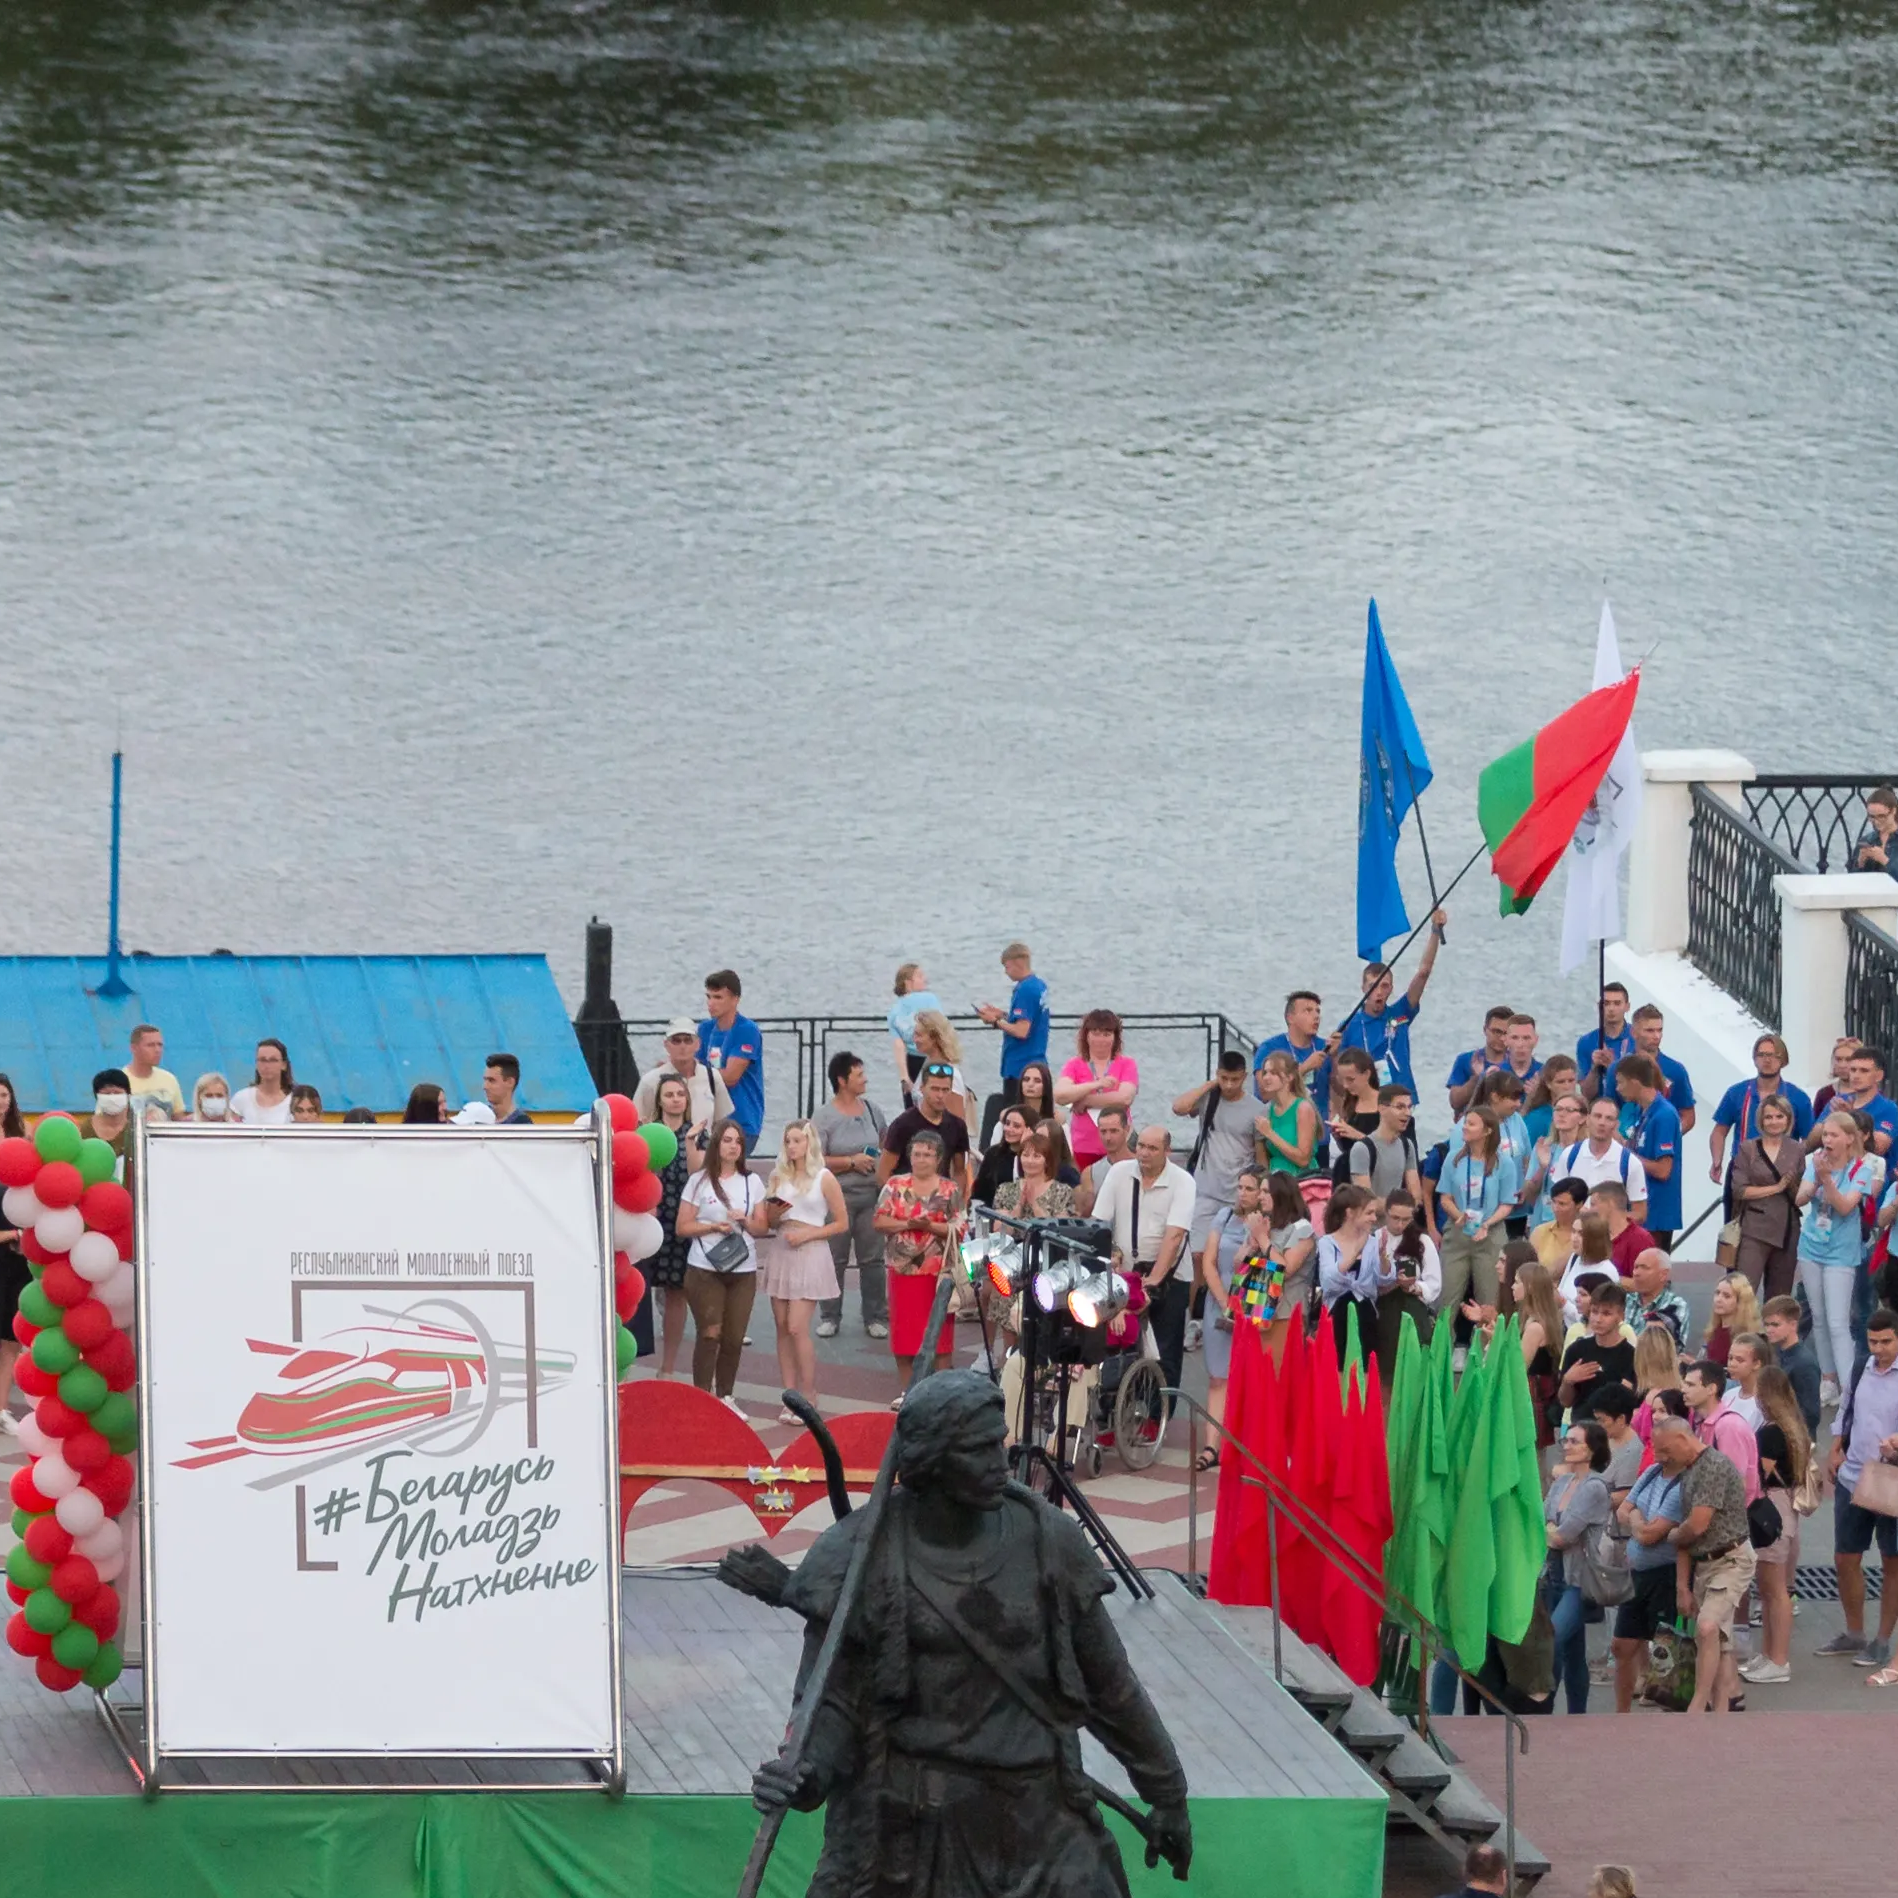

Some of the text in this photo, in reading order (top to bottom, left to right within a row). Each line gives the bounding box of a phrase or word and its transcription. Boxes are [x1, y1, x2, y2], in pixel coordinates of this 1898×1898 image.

[290, 1248, 535, 1277] РЕСПУБЛИКАНСКИЙ МОЛОДЕЖНЫЙ ПОЕЗД
[366, 1504, 561, 1576] Моладзь
[387, 1558, 598, 1623] Натхненне
